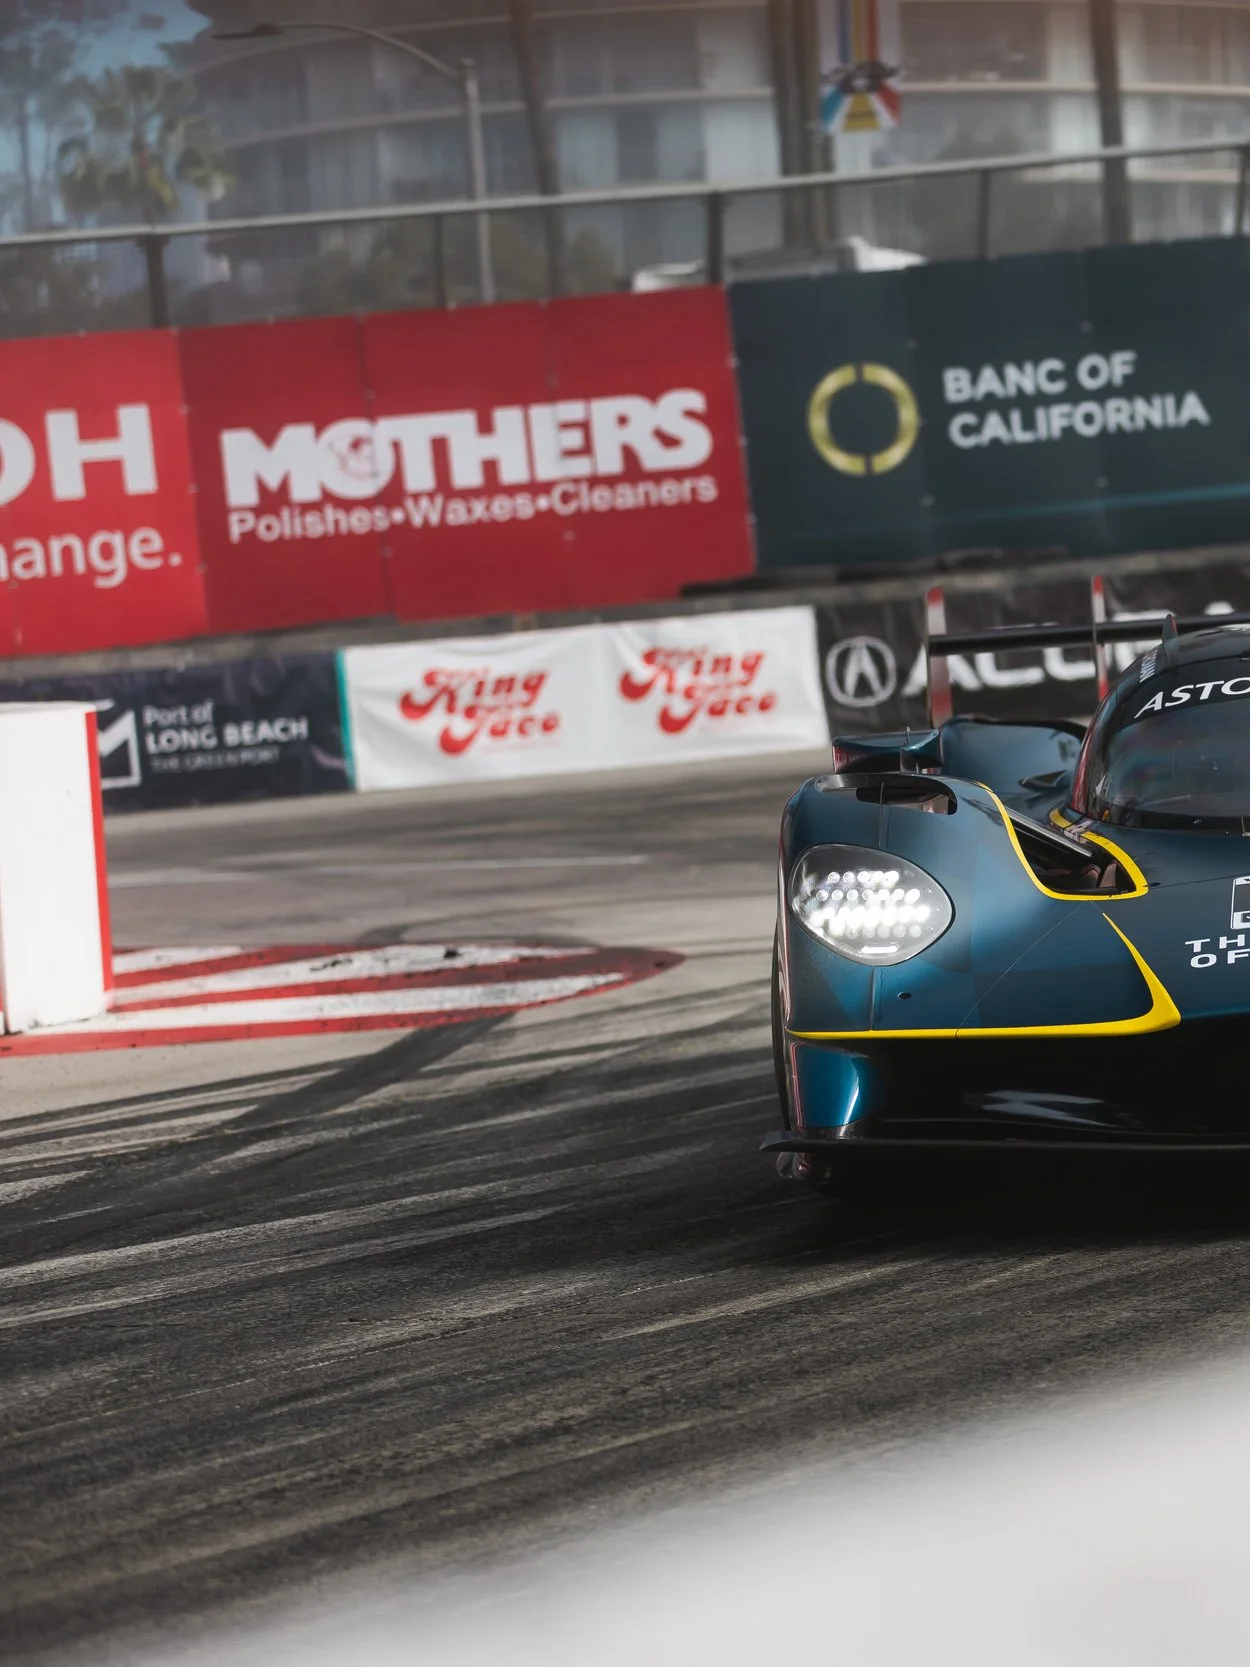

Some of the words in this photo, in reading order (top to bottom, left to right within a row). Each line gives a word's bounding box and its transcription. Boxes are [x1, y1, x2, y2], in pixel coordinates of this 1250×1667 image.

[943, 358, 1067, 402] BANC
[1076, 350, 1137, 392] OF
[947, 391, 1211, 449] CALIFORNIA
[220, 389, 713, 508] MOTHERS
[0, 527, 182, 588] ange.
[399, 668, 549, 722] King
[619, 647, 764, 702] King
[142, 704, 188, 727] Port
[191, 698, 214, 725] of
[145, 727, 218, 755] LONG
[223, 715, 309, 749] BEACH
[439, 703, 561, 757] Taco
[658, 684, 778, 735] Taco
[1190, 948, 1250, 968] OF
